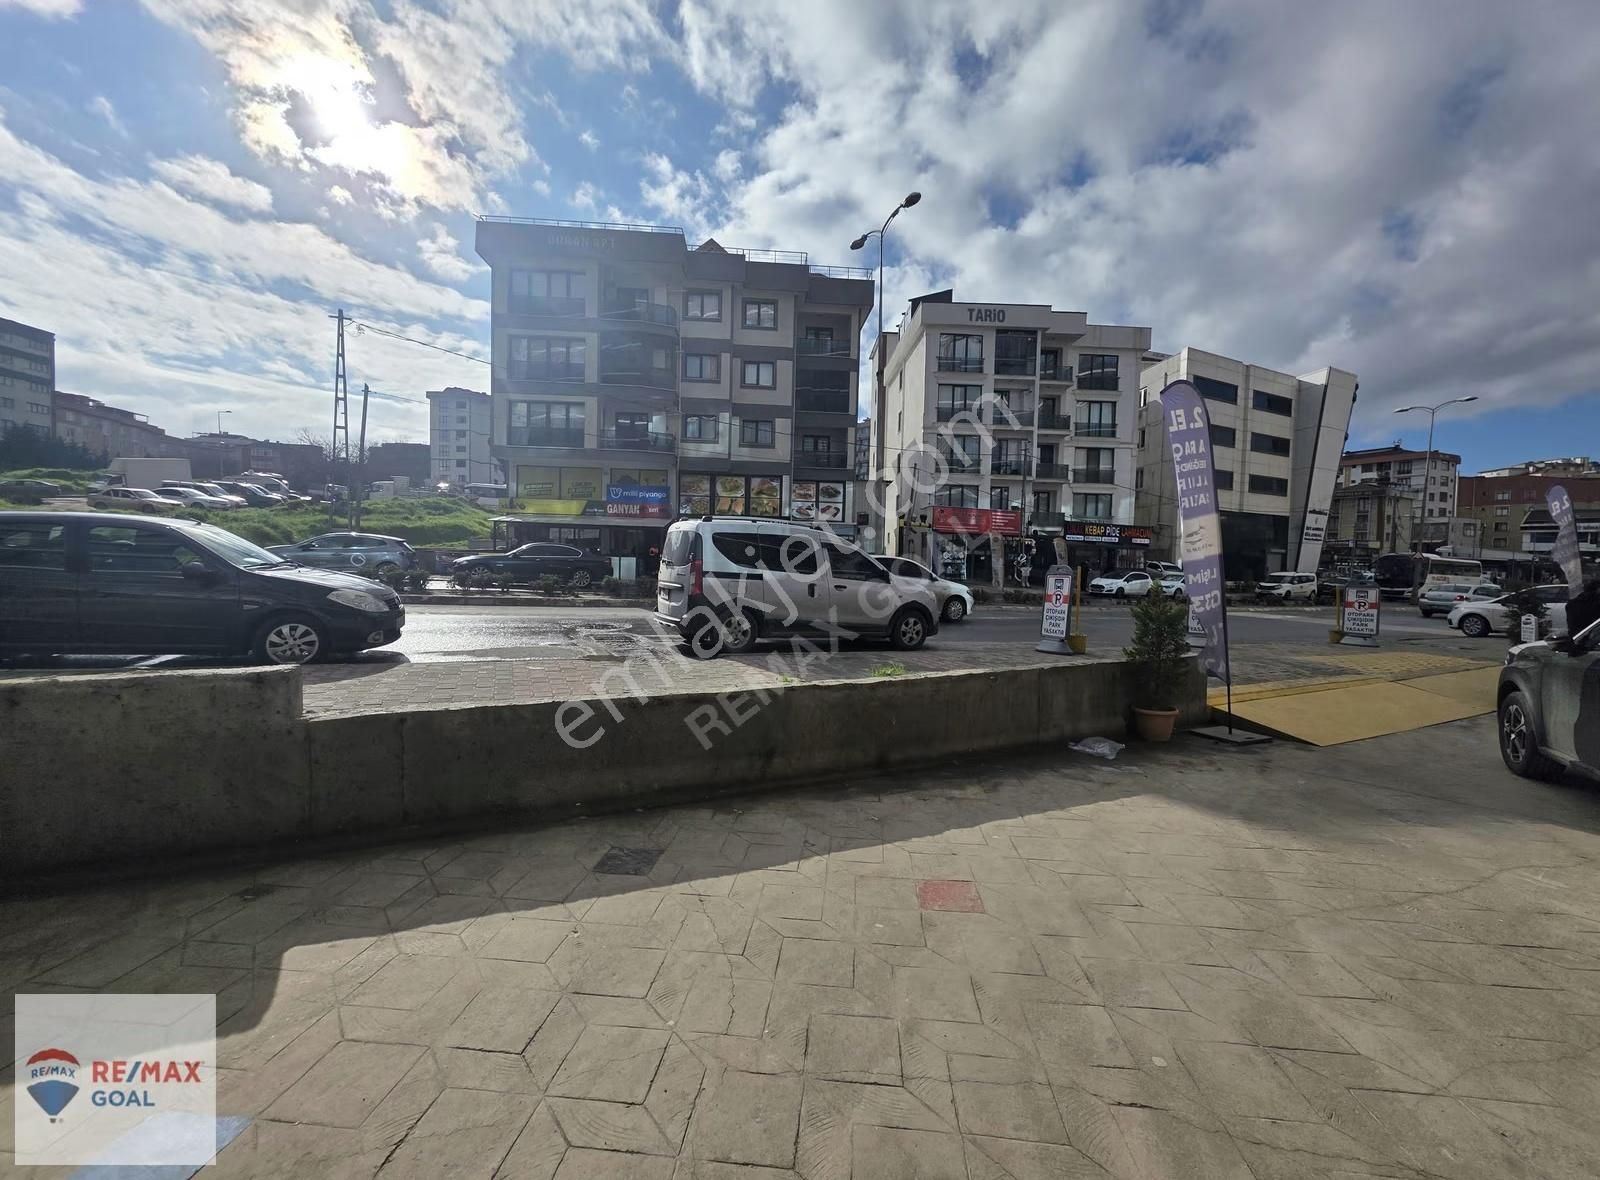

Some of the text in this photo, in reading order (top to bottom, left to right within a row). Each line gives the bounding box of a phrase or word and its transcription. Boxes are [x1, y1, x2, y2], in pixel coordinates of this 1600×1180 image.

[639, 490, 667, 499] piyango
[607, 503, 640, 515] GANYAN
[1084, 525, 1105, 536] KEBAP
[1106, 525, 1120, 537] PİDE
[1043, 628, 1065, 636] YASAKTIR
